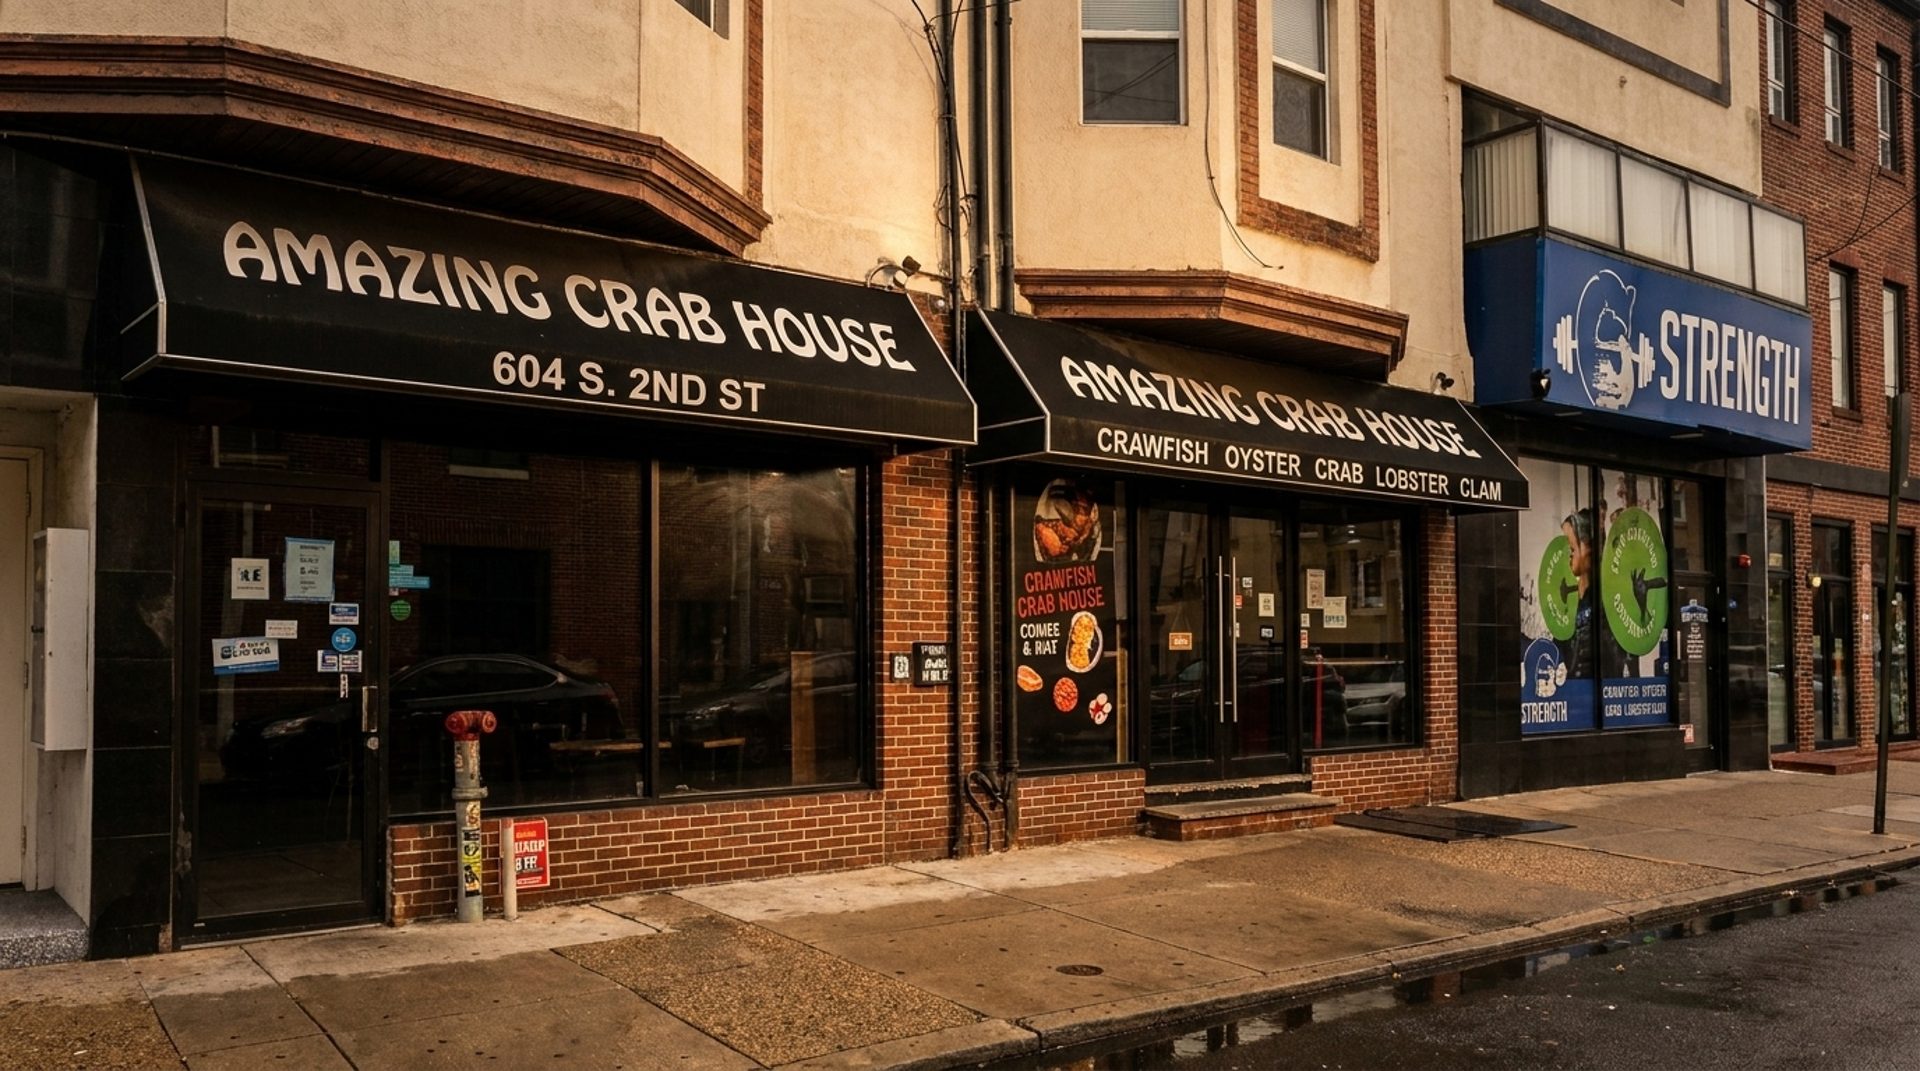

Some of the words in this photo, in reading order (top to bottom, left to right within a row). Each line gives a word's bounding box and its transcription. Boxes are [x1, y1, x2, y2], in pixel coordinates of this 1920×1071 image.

[223, 221, 551, 320] AMAZING
[563, 274, 727, 345] CRAB
[731, 300, 917, 372] HOUSE
[491, 351, 566, 391] 604
[578, 361, 616, 397] S.
[628, 367, 707, 406] 2ND
[718, 378, 766, 413] ST
[1060, 355, 1261, 426] AMAZING
[1256, 390, 1366, 442] CRAB
[1355, 407, 1482, 459] HOUSE
[1659, 309, 1801, 425] STRENGTH
[1097, 427, 1209, 466] CRAWFISH
[1224, 444, 1302, 478] OYSTER
[1314, 457, 1365, 485] CRAB
[1375, 465, 1451, 496] LOBSTER
[1459, 477, 1503, 502] CLAM
[1017, 593, 1056, 618] CRAB
